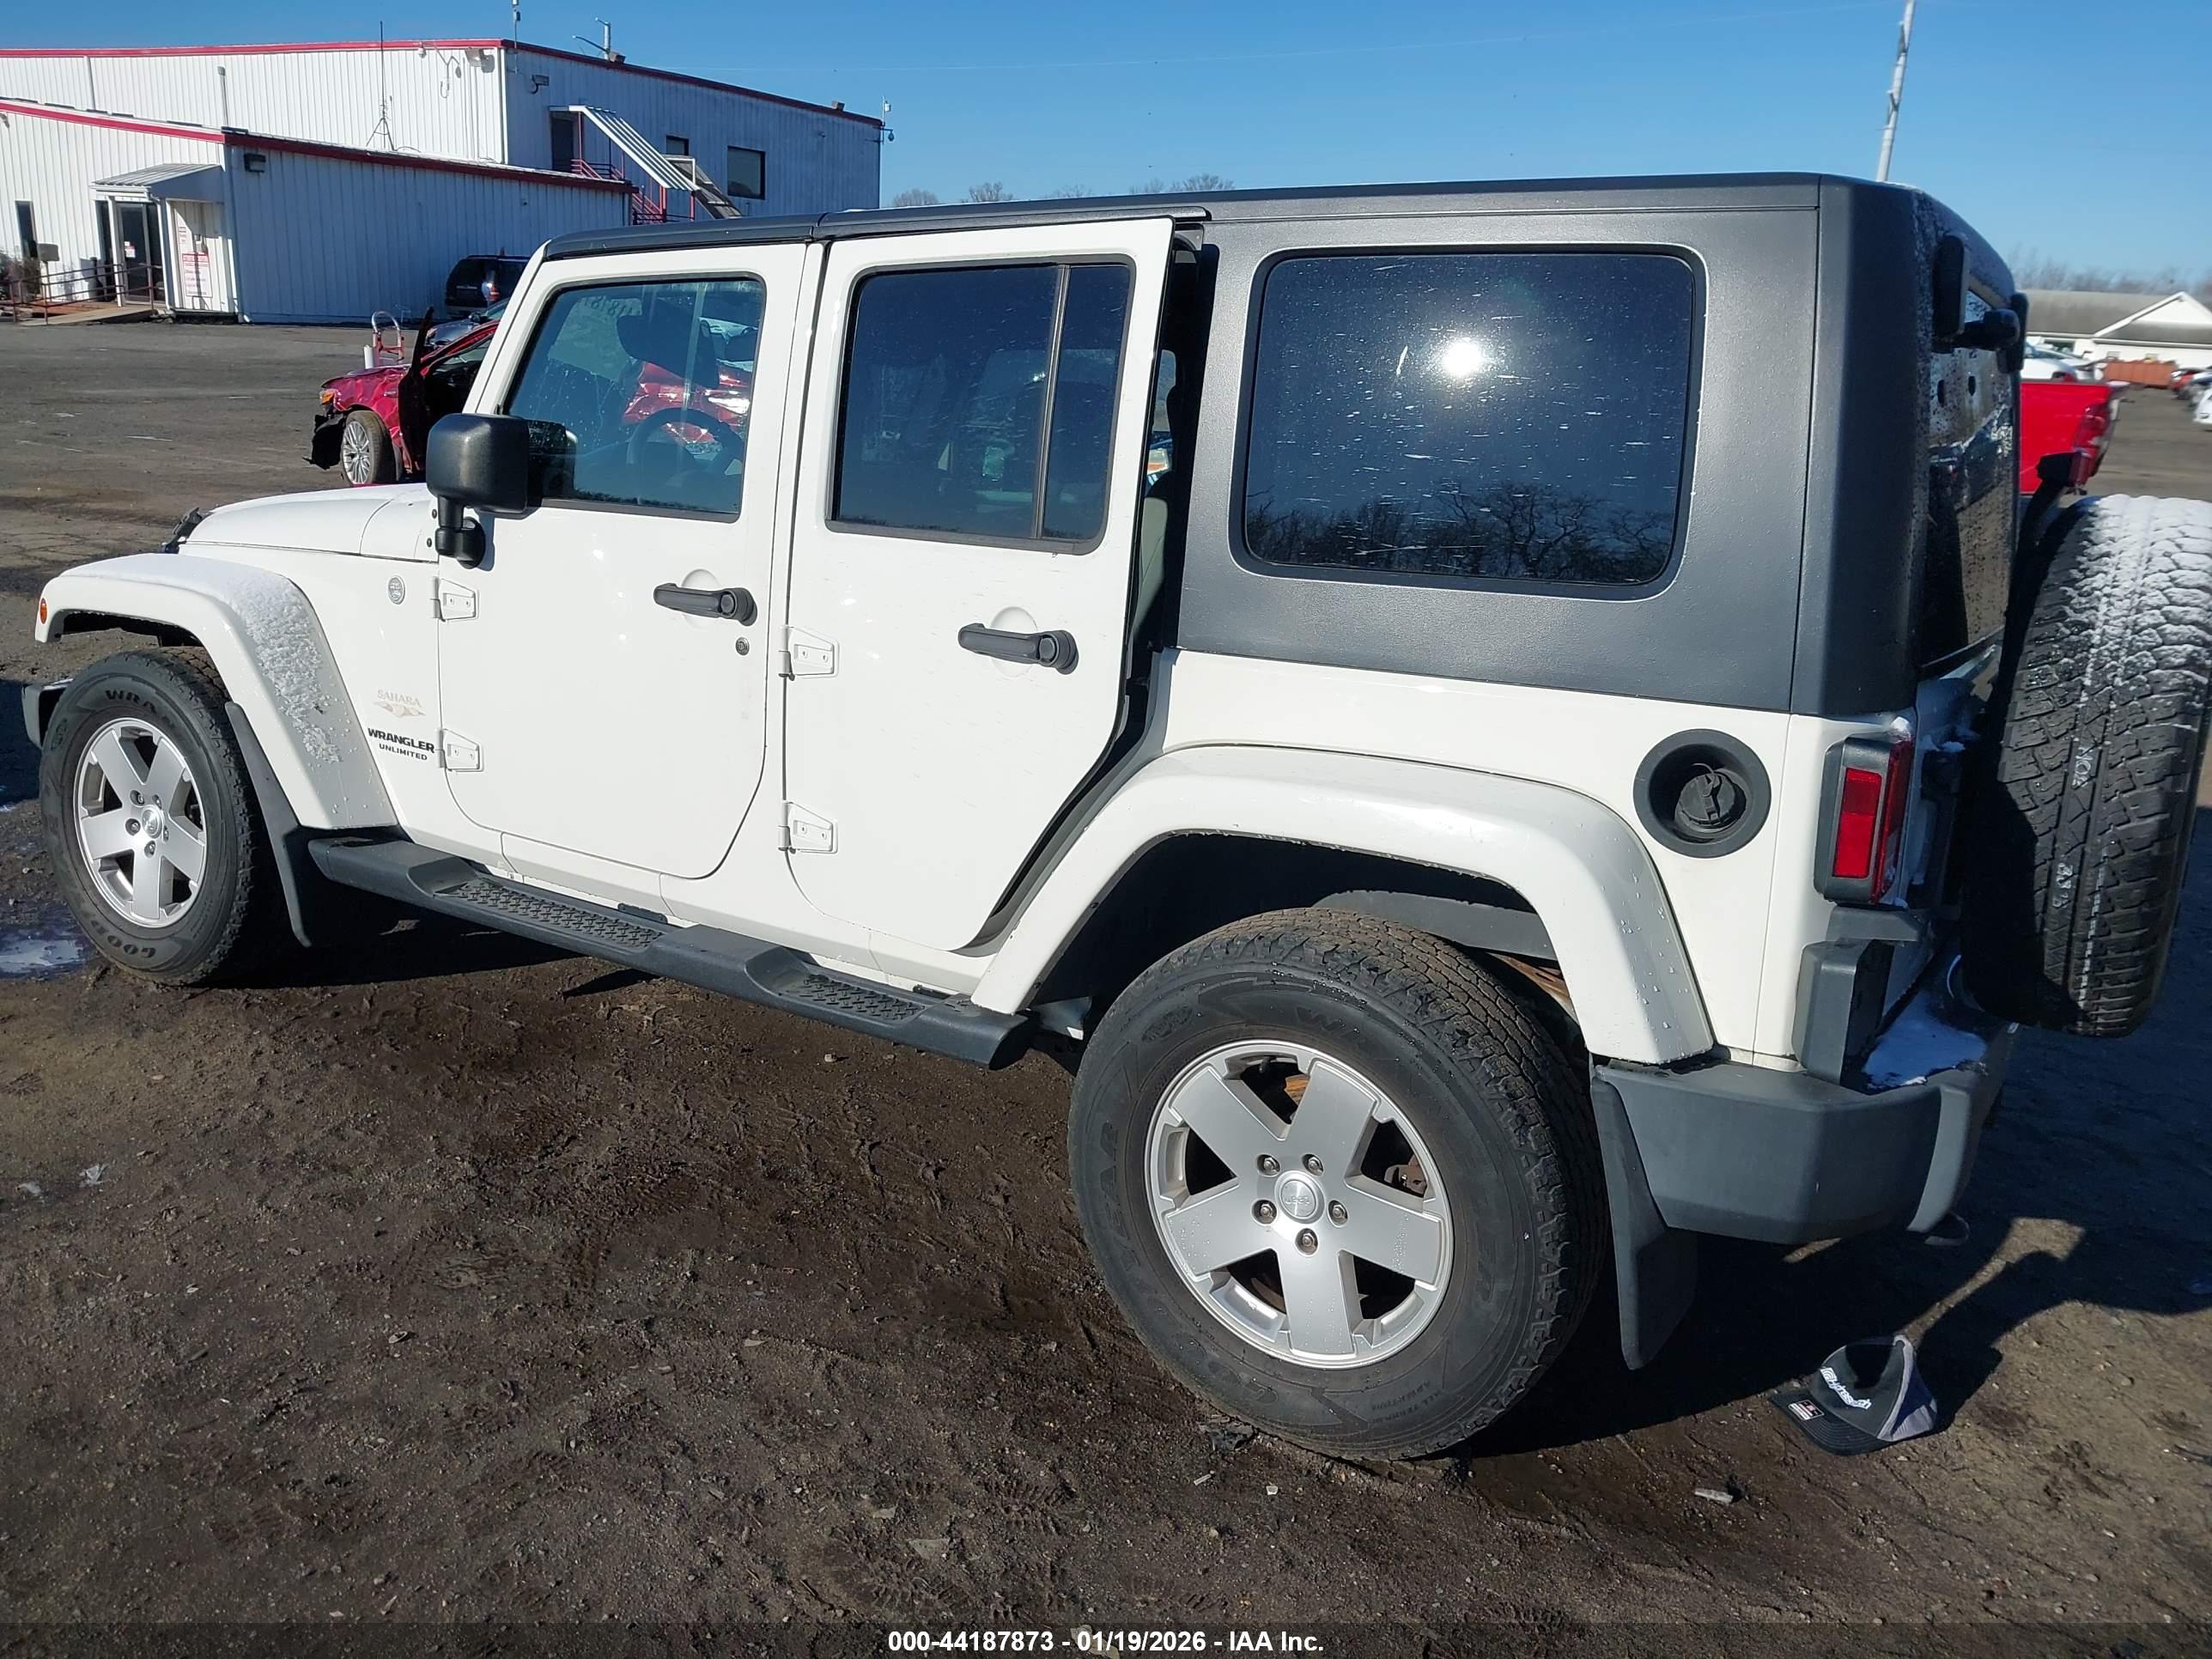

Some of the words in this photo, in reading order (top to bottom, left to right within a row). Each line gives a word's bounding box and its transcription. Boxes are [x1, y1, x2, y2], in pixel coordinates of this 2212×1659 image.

[378, 690, 422, 708] SAHARA
[368, 727, 434, 753] WRANGLER
[379, 743, 428, 760] UNLIMITED
